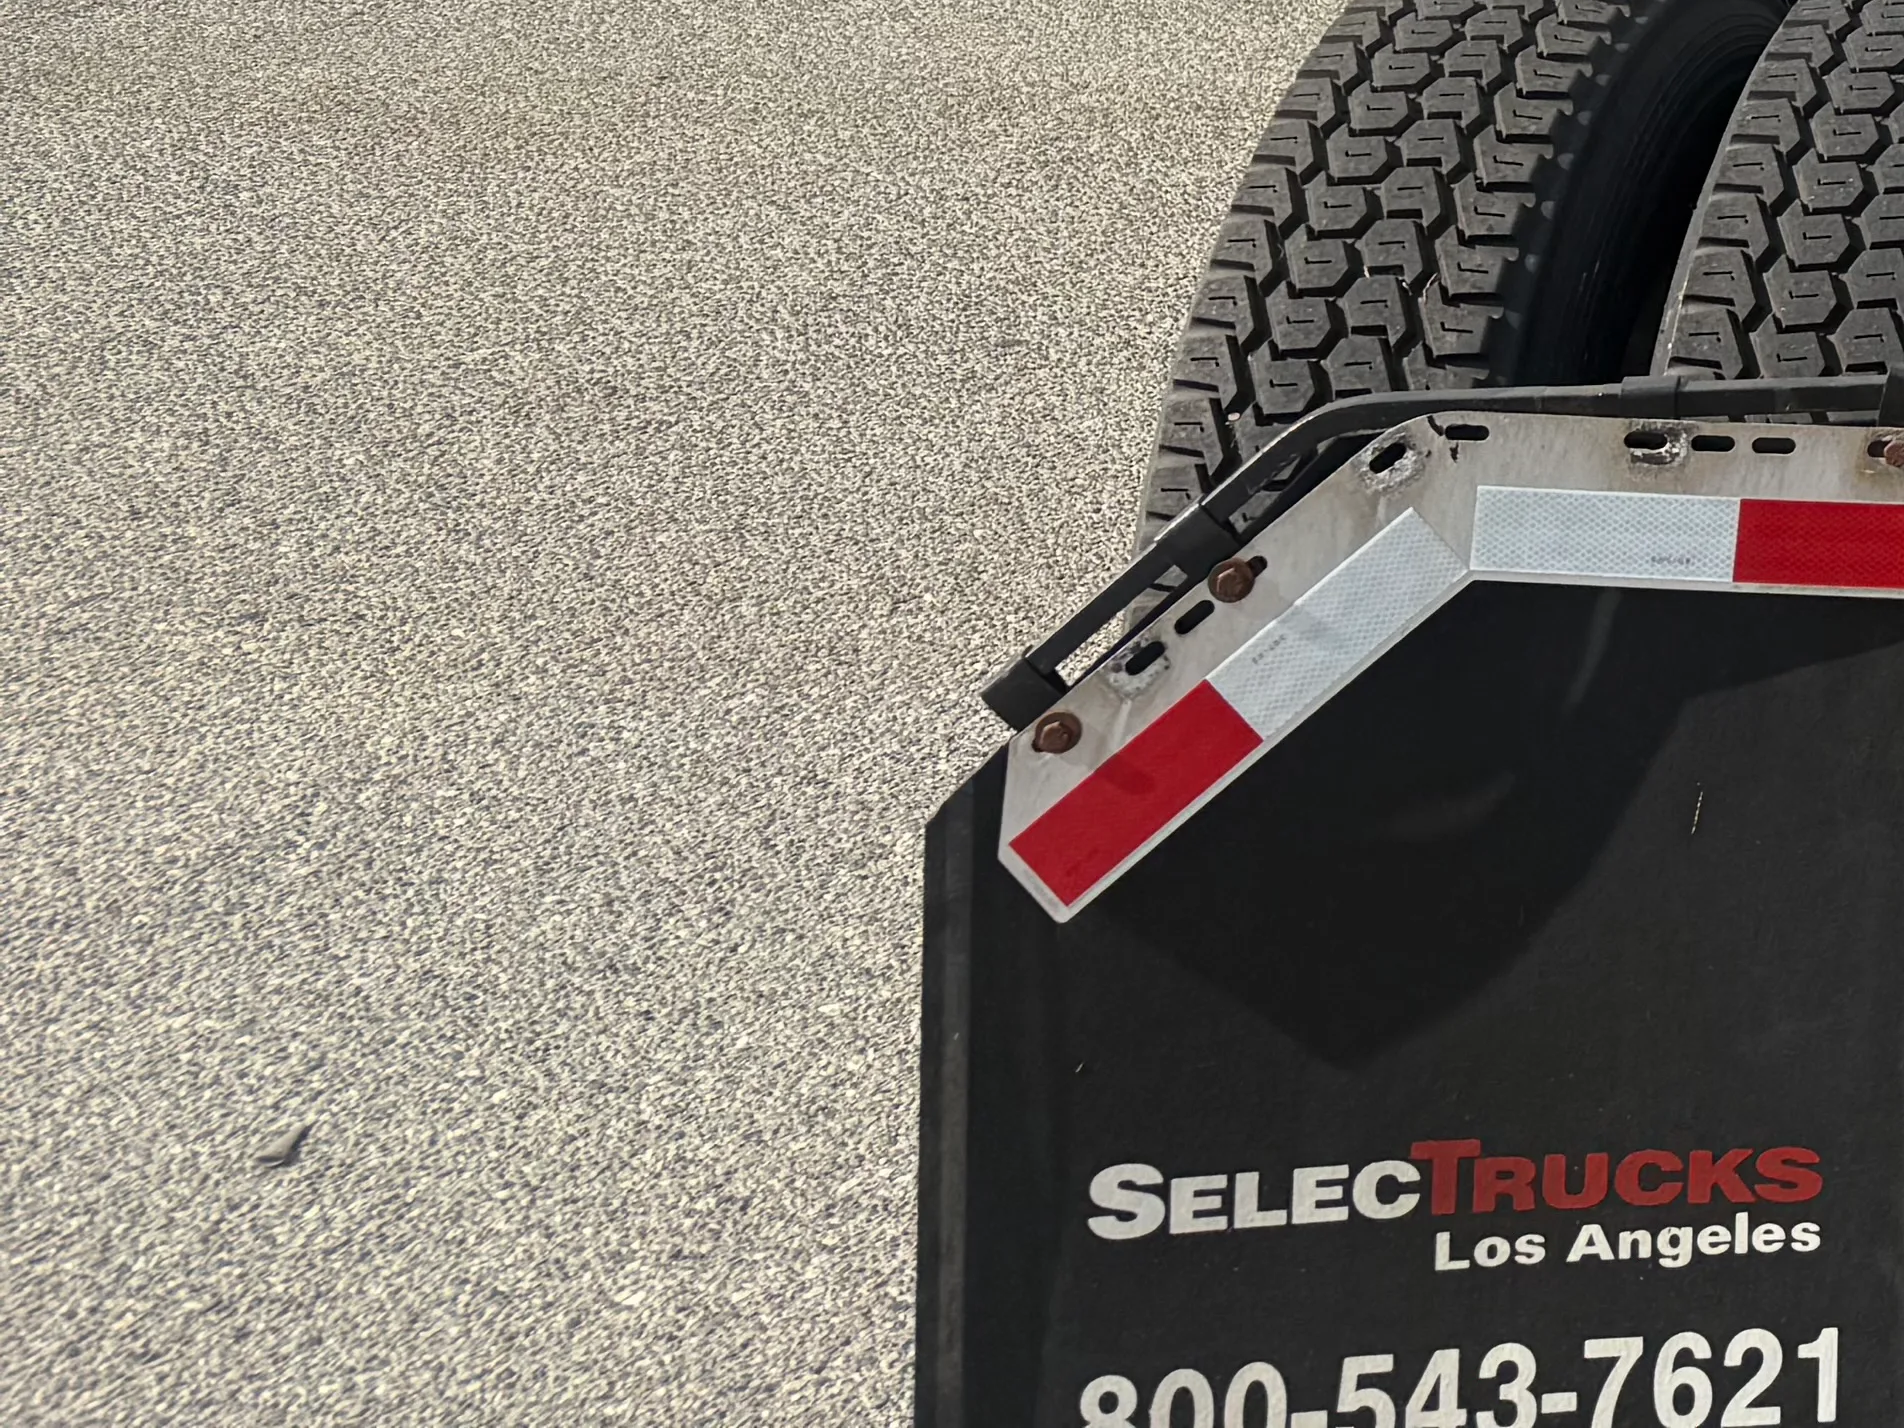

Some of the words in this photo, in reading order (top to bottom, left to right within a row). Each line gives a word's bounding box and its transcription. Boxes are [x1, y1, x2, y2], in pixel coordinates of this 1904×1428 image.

[1434, 1230, 1547, 1272] Los
[1566, 1212, 1822, 1270] Angeles
[1079, 1326, 1839, 1428] 800-543-7621
